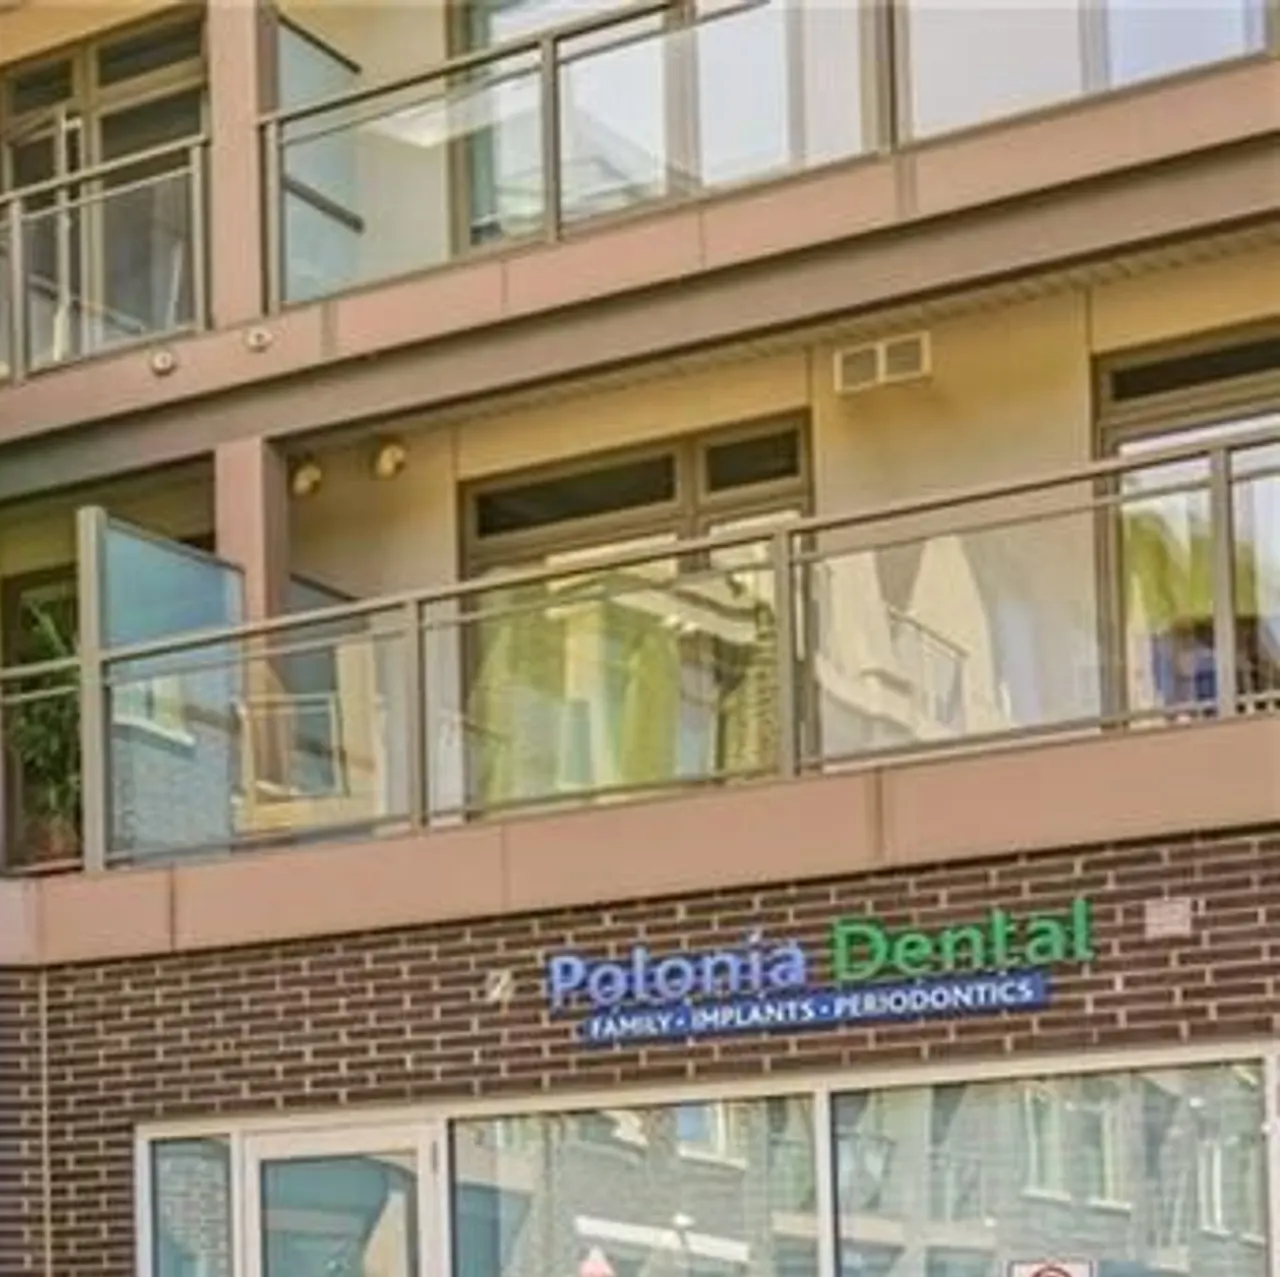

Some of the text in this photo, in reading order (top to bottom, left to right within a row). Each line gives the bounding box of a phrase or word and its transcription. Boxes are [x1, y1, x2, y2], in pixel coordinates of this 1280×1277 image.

[548, 898, 1095, 1009] Polonia Dental
[591, 979, 1034, 1039] FAMILY IMPLANTS PERIODONTICS
